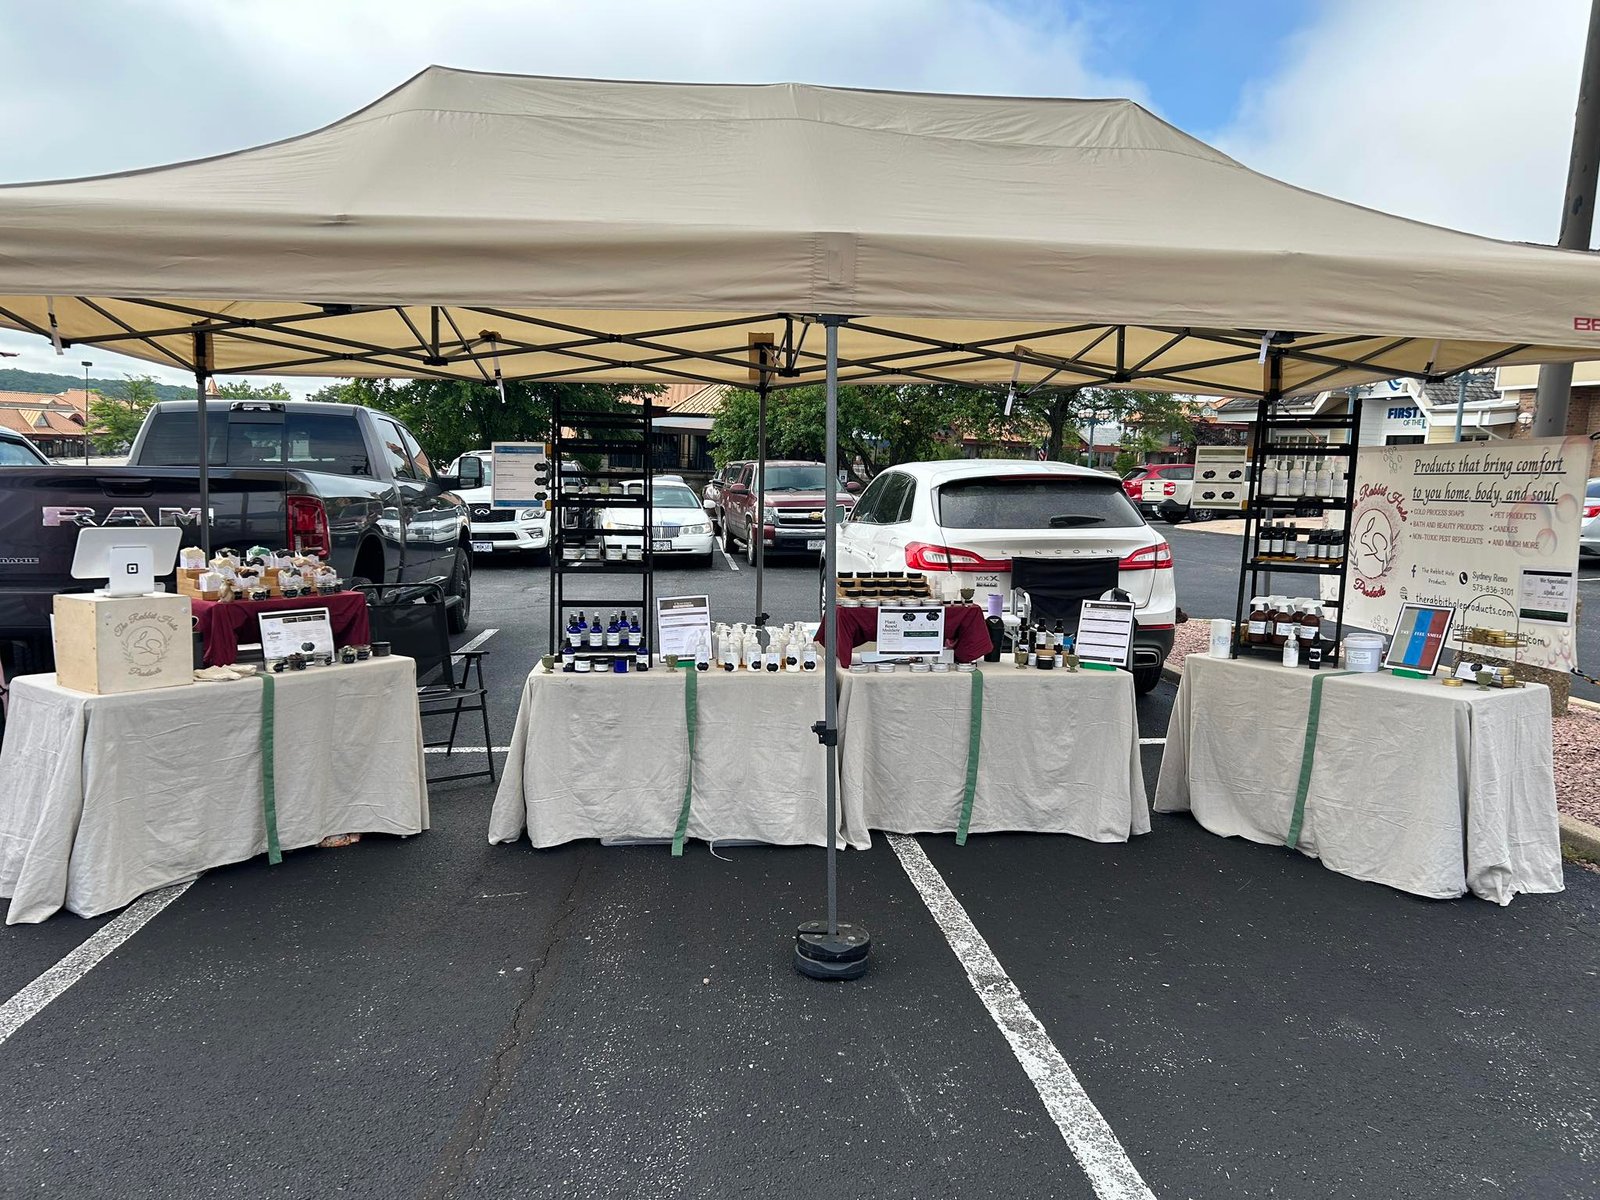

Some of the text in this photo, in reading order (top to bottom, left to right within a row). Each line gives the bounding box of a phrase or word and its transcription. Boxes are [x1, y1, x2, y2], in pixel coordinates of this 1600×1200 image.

[1387, 407, 1419, 419] FIRST
[1414, 451, 1564, 480] Products that bring comfort
[1360, 483, 1388, 502] Rabbit
[1412, 481, 1559, 508] to you home, body, and soul.
[42, 506, 214, 527] RAM
[1414, 508, 1426, 516] COLD
[1426, 509, 1447, 517] PROCESS
[1506, 512, 1537, 520] PRODUCTS
[1457, 523, 1484, 531] PRODUCTS
[1493, 525, 1519, 533] CANDLES
[1412, 533, 1438, 541] NON-TOXIC
[1452, 536, 1484, 544] REPELLENTS
[1522, 541, 1540, 549] MORE
[1001, 548, 1113, 556] LINCOLN
[1429, 567, 1444, 576] Rabbit
[1472, 571, 1508, 583] Sydney Reno
[1428, 578, 1447, 586] Products
[1472, 584, 1514, 597] 573-836-3101
[128, 611, 158, 624] Rabbit
